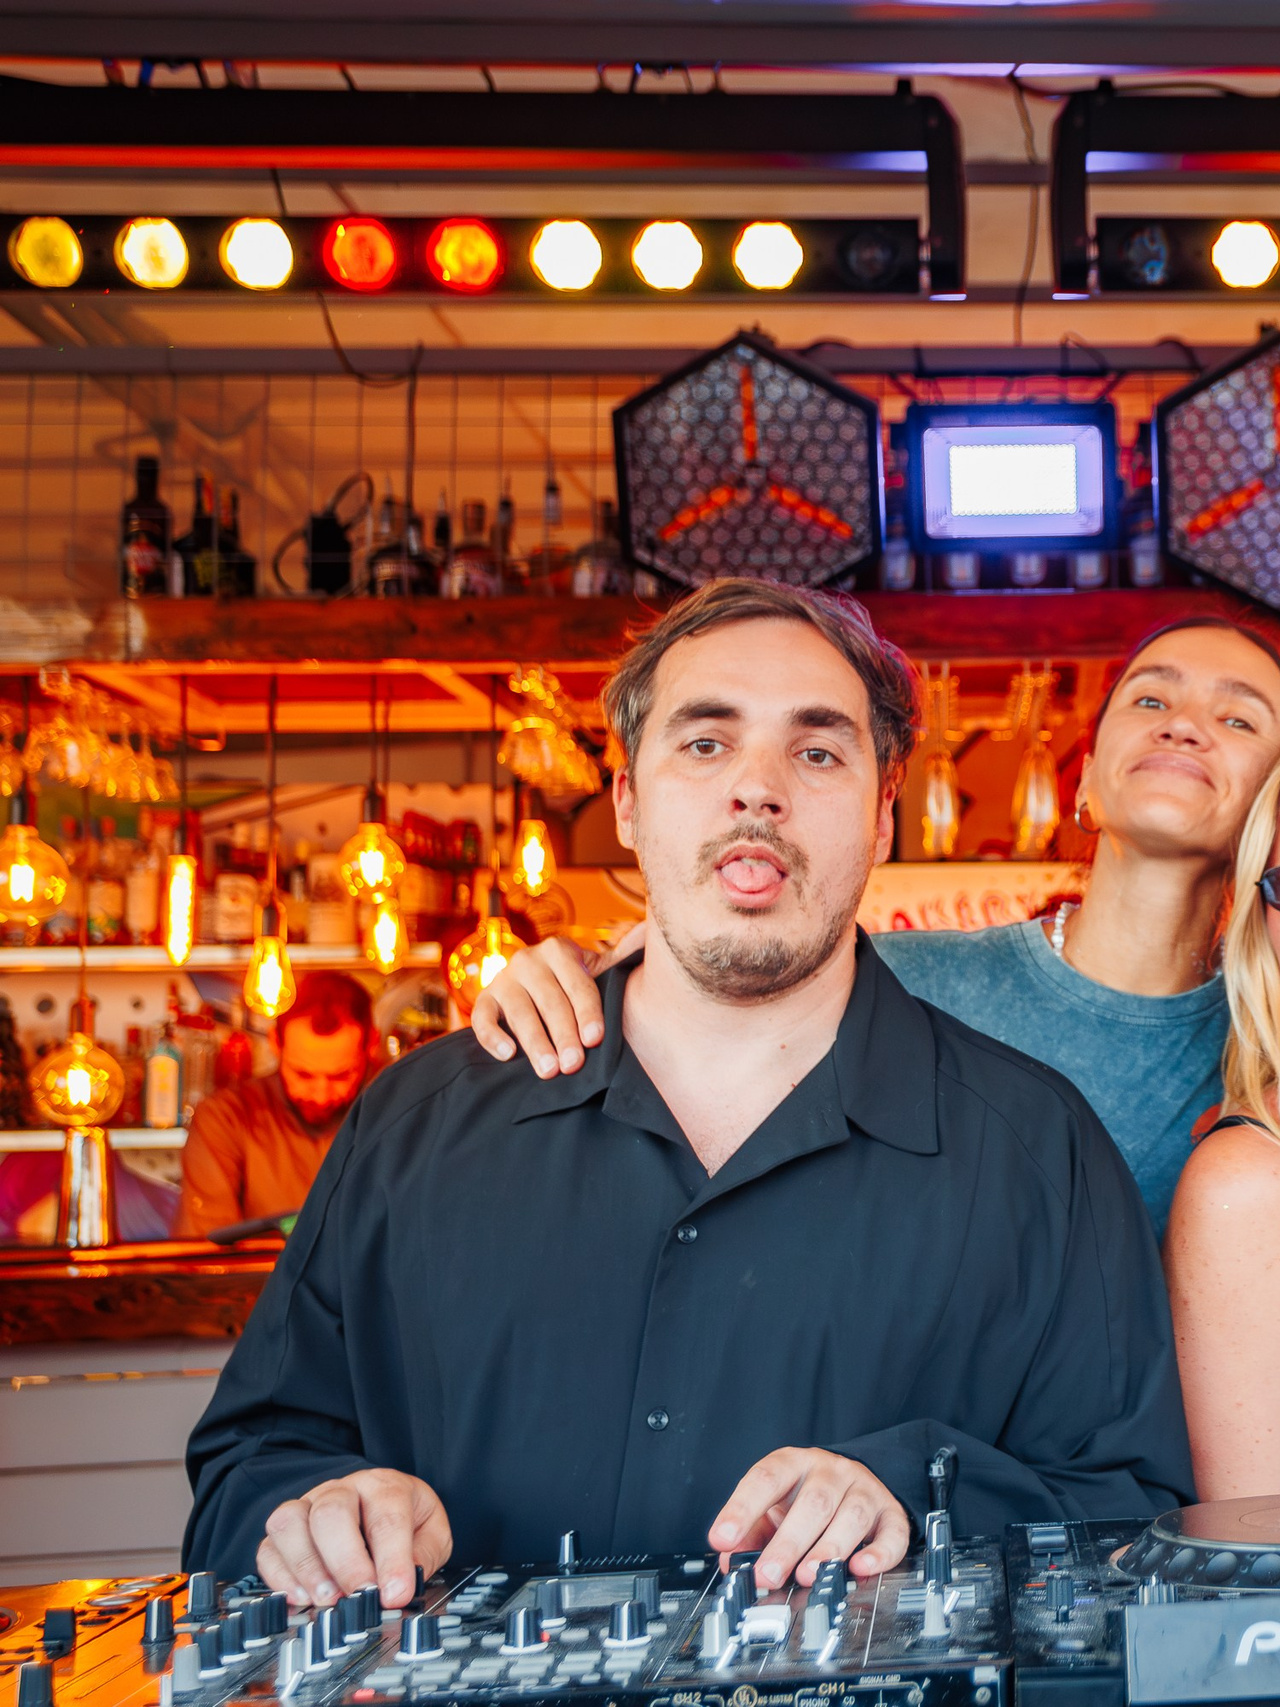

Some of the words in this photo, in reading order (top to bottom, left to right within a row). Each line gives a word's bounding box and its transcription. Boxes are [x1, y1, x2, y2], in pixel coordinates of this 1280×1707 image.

[818, 1682, 845, 1697] CH1
[800, 1697, 830, 1707] PHONO
[842, 1696, 856, 1706] CD
